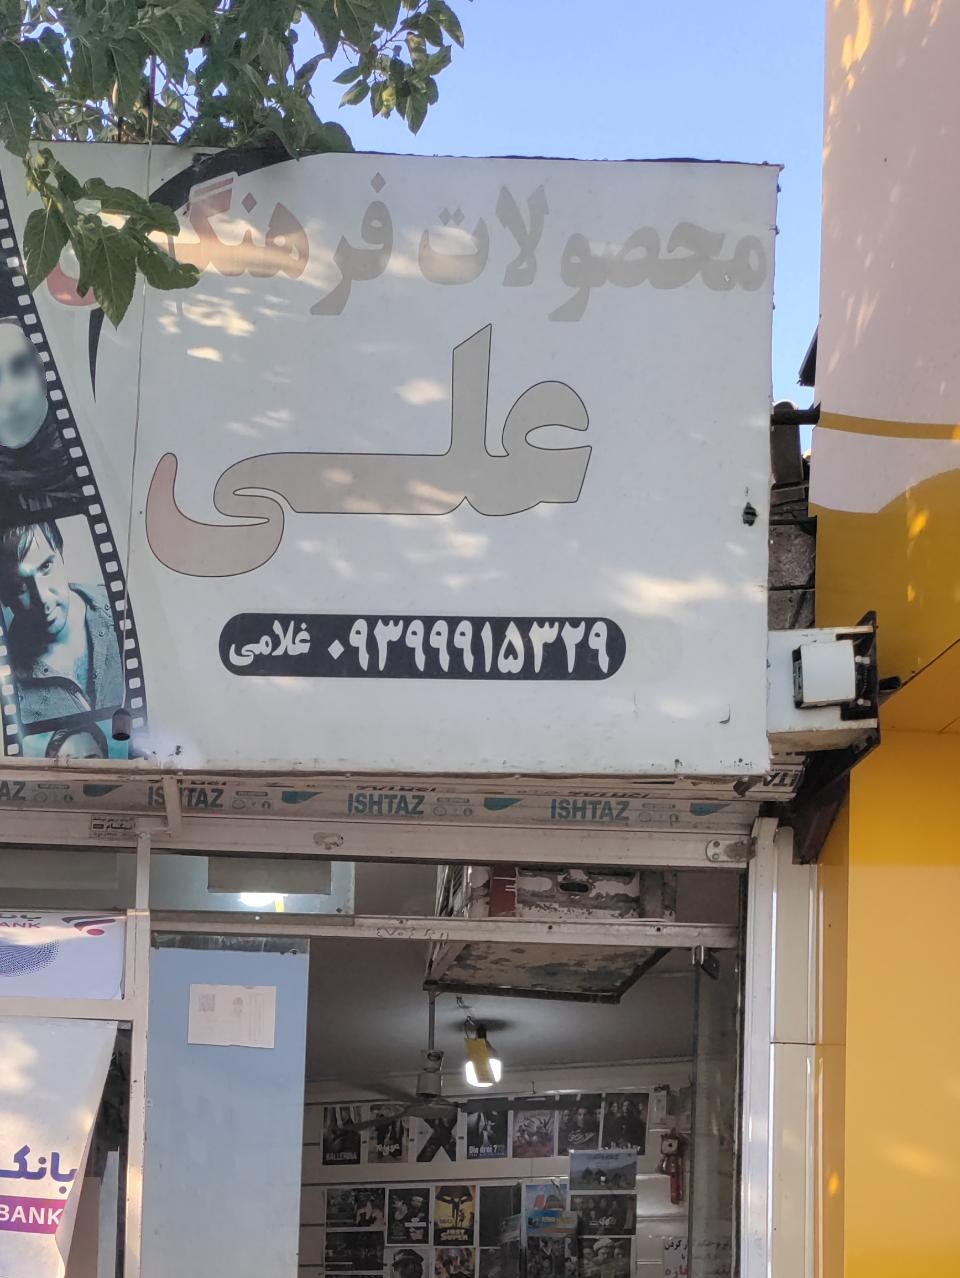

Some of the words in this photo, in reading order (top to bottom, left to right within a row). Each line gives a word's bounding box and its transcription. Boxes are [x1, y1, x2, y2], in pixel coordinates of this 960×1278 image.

[417, 184, 767, 322] محصولات
[145, 323, 592, 577] علی
[229, 619, 311, 666] غلامی
[327, 618, 610, 675] ۰۹۳۹۹۹۱۵۳۲۹
[148, 785, 224, 808] ISTAZ
[348, 793, 425, 815] ISHTAZ
[550, 799, 630, 821] ISHTAZ
